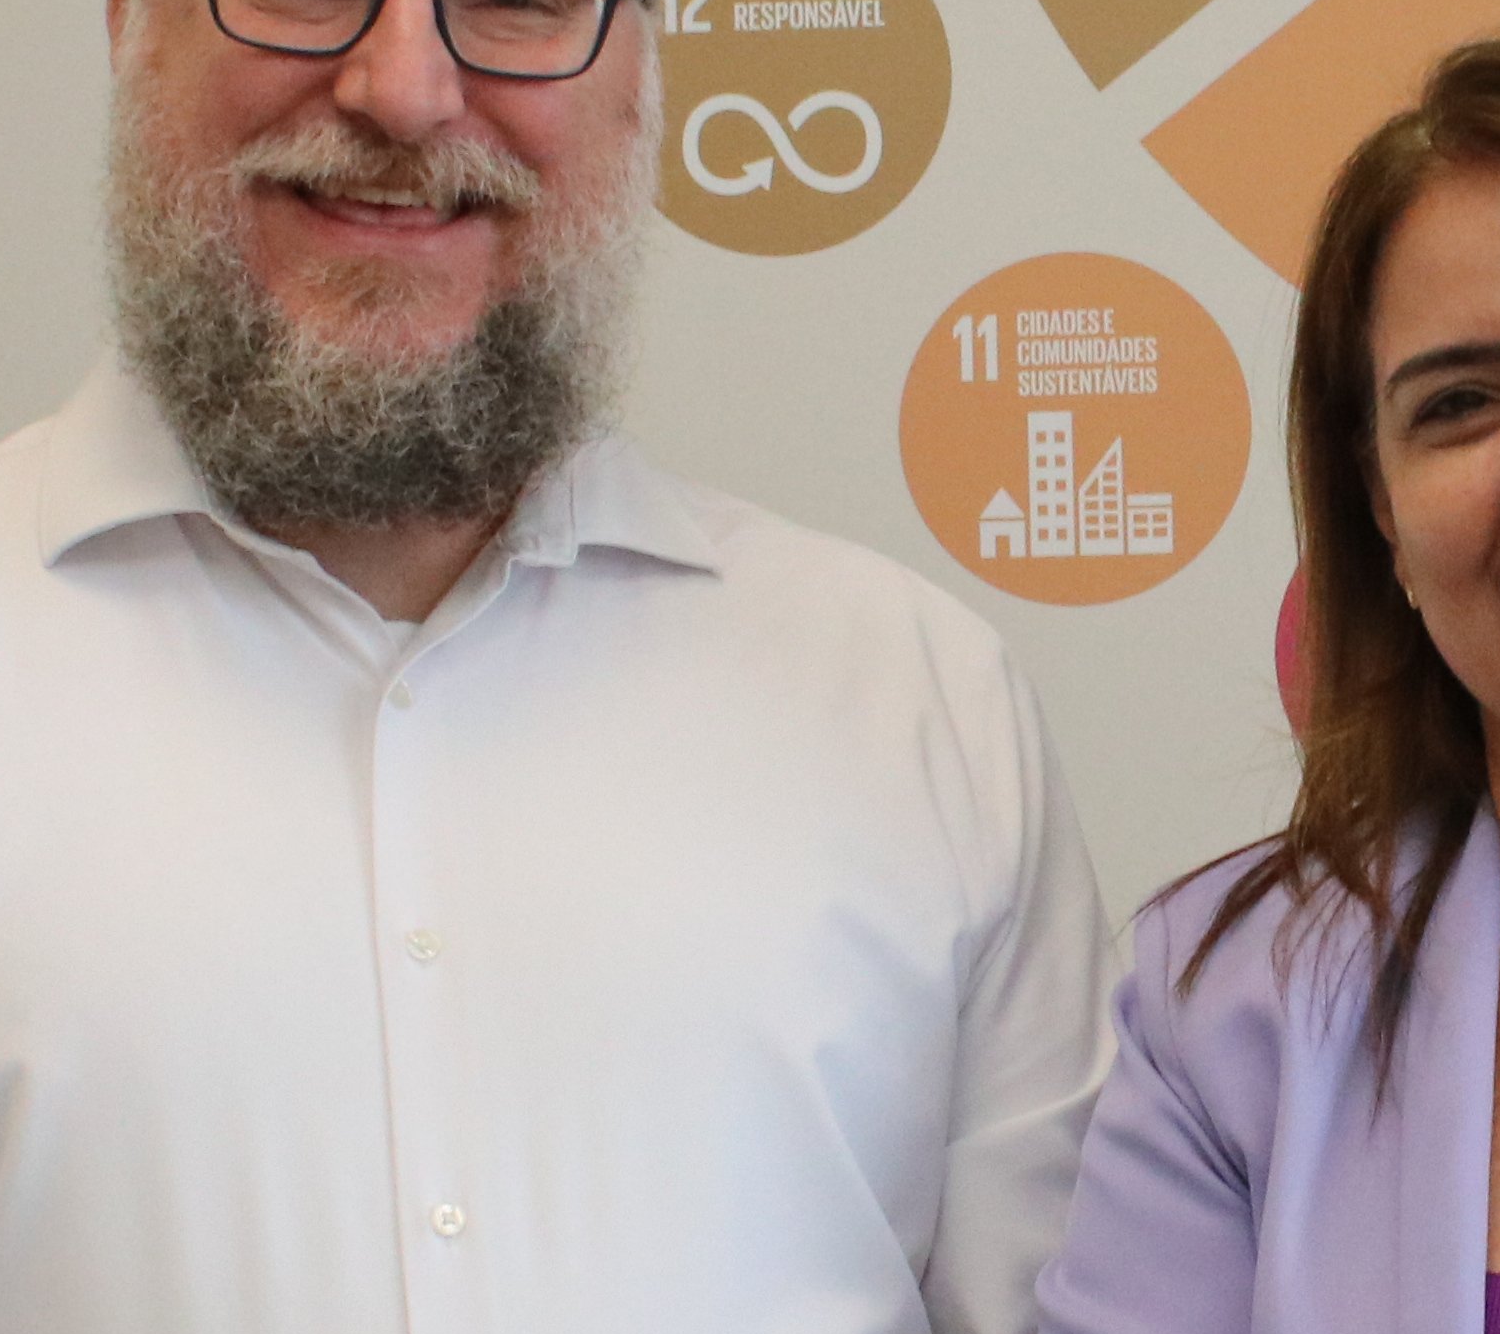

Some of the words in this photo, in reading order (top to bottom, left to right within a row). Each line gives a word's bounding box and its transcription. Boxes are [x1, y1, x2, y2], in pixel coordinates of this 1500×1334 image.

[1016, 309, 1100, 337] CIDADES
[1103, 308, 1115, 334] E
[952, 313, 999, 383] 11
[1016, 336, 1158, 367] COMUNIDADES
[1016, 363, 1158, 397] SUSTENTÁVEIS
